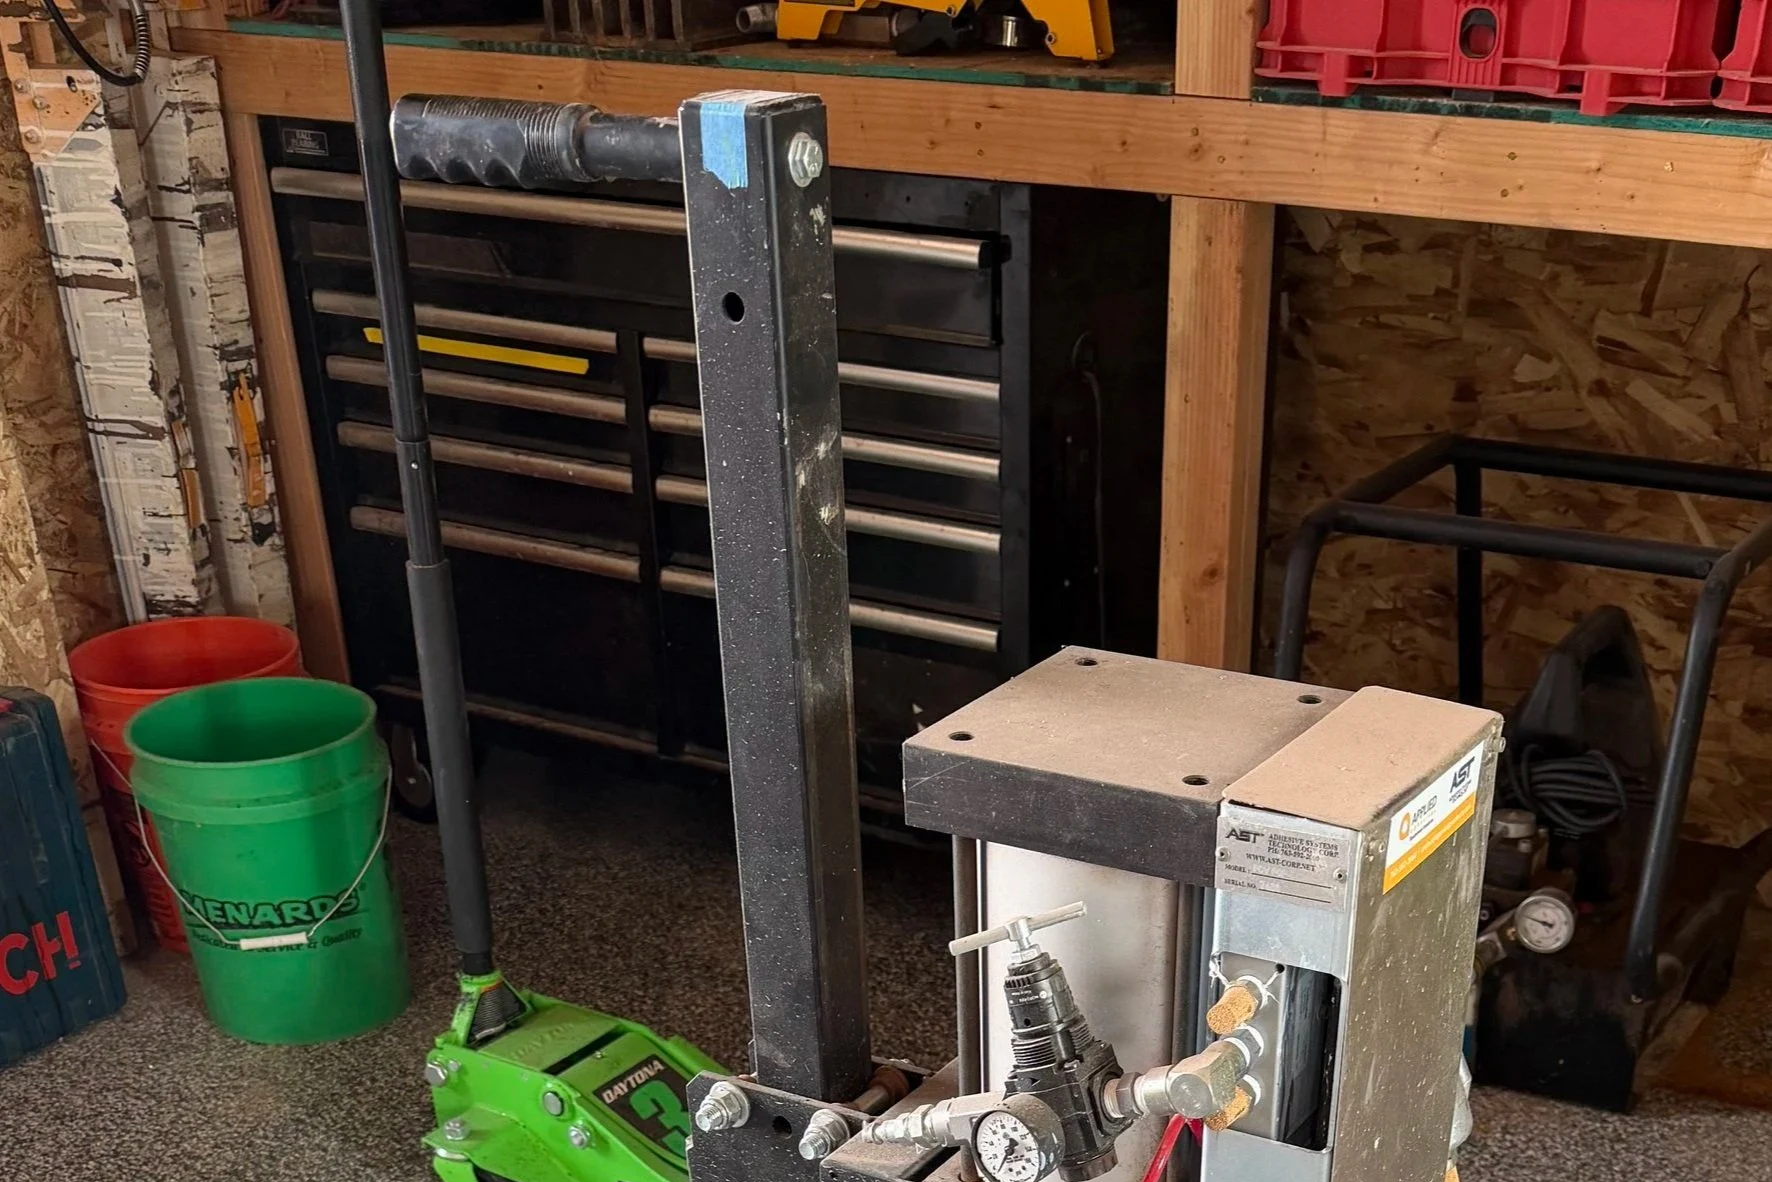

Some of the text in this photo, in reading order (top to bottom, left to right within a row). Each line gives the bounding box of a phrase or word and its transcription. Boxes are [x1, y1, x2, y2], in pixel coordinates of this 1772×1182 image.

[1449, 756, 1475, 793] AST
[1413, 795, 1437, 822] APPLIED
[1225, 827, 1259, 843] AST
[1268, 833, 1339, 851] ADHESIVE SYSTEMS
[179, 889, 360, 930] MENARDS
[322, 928, 363, 947] Quality
[602, 1059, 665, 1105] DAYTONA
